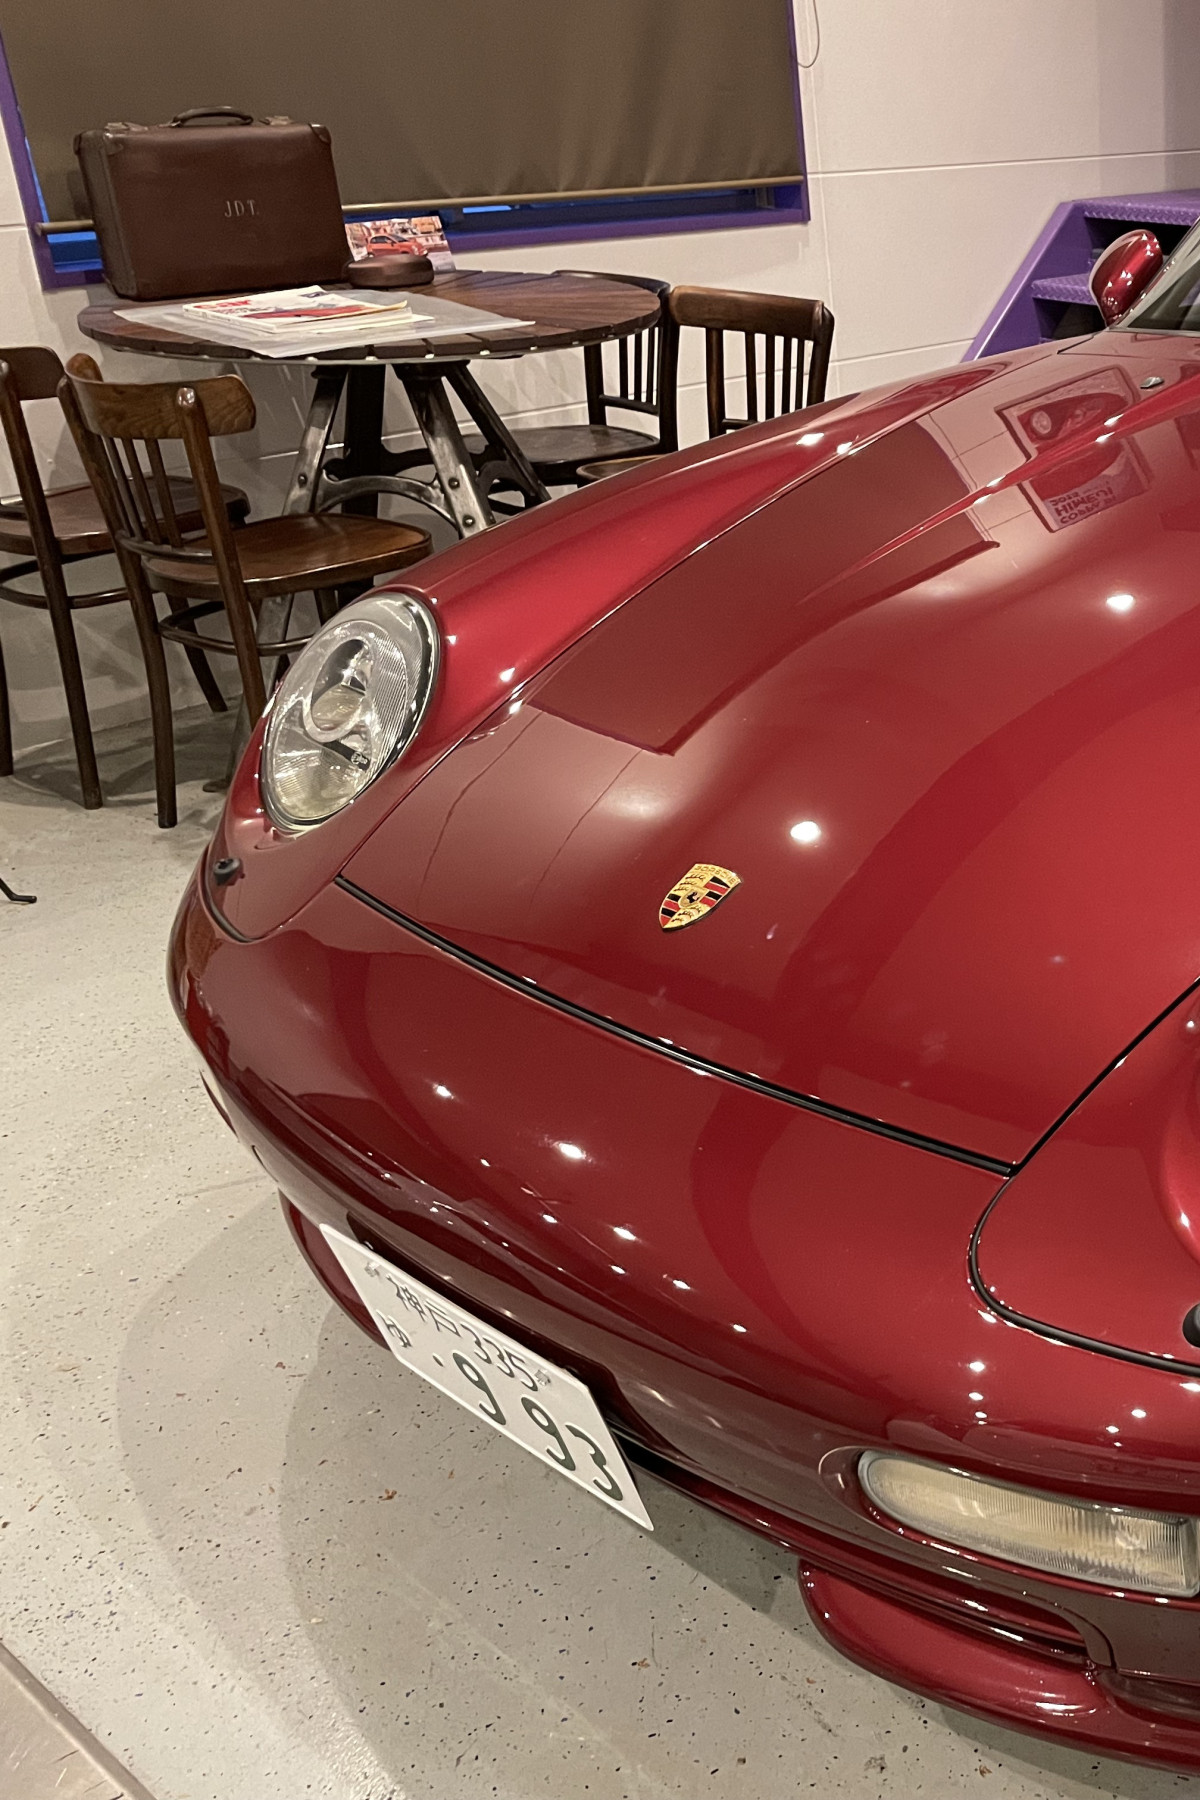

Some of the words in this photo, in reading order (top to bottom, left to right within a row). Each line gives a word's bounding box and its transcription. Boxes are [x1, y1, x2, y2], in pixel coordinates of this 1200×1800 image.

[377, 1310, 413, 1349] ゆ
[385, 1275, 461, 1338] 神戸
[460, 1322, 540, 1393] 335
